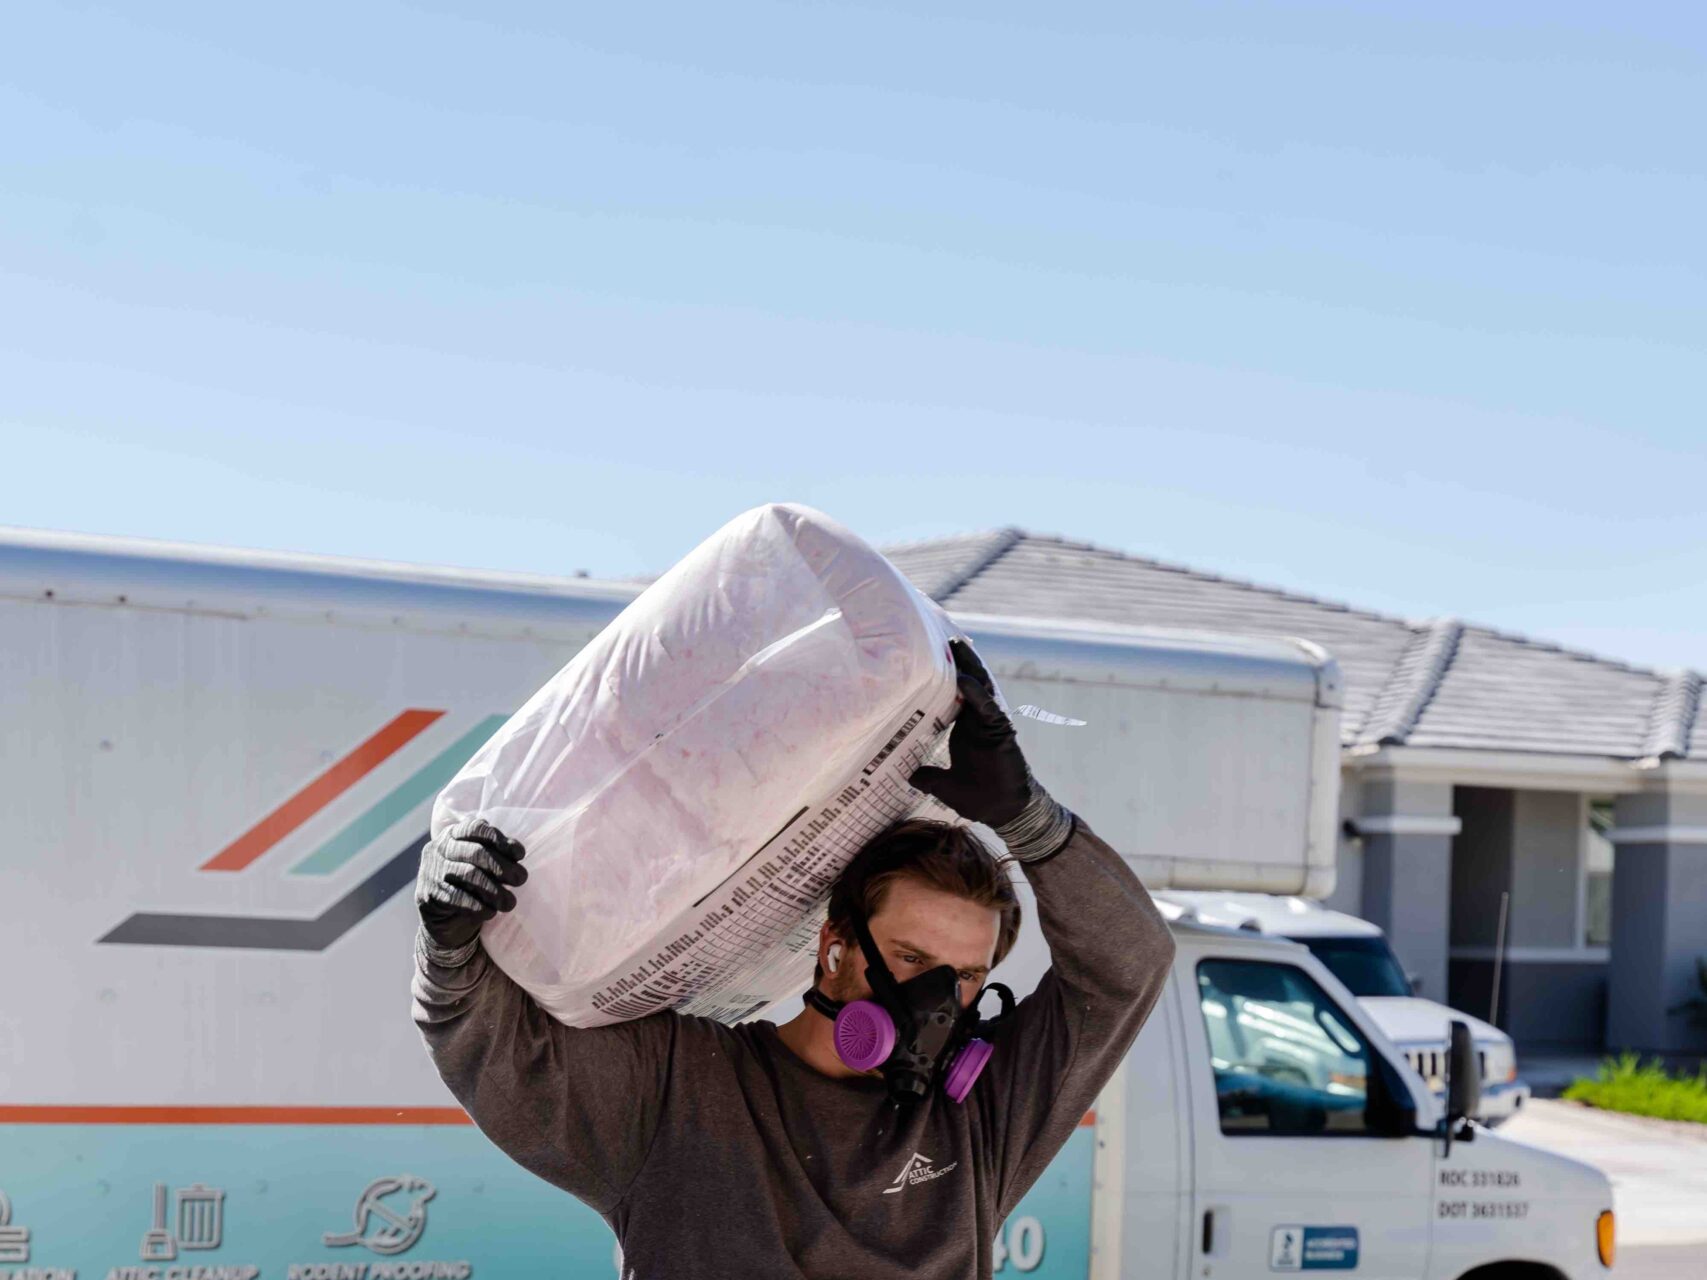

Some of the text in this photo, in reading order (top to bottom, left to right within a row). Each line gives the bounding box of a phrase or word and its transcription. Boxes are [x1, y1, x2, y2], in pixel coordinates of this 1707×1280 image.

[908, 1166, 933, 1180] ATTIC
[909, 1161, 958, 1185] CONSTRUCTION
[1440, 1169, 1466, 1187] ROC
[1439, 1200, 1467, 1219] DOT
